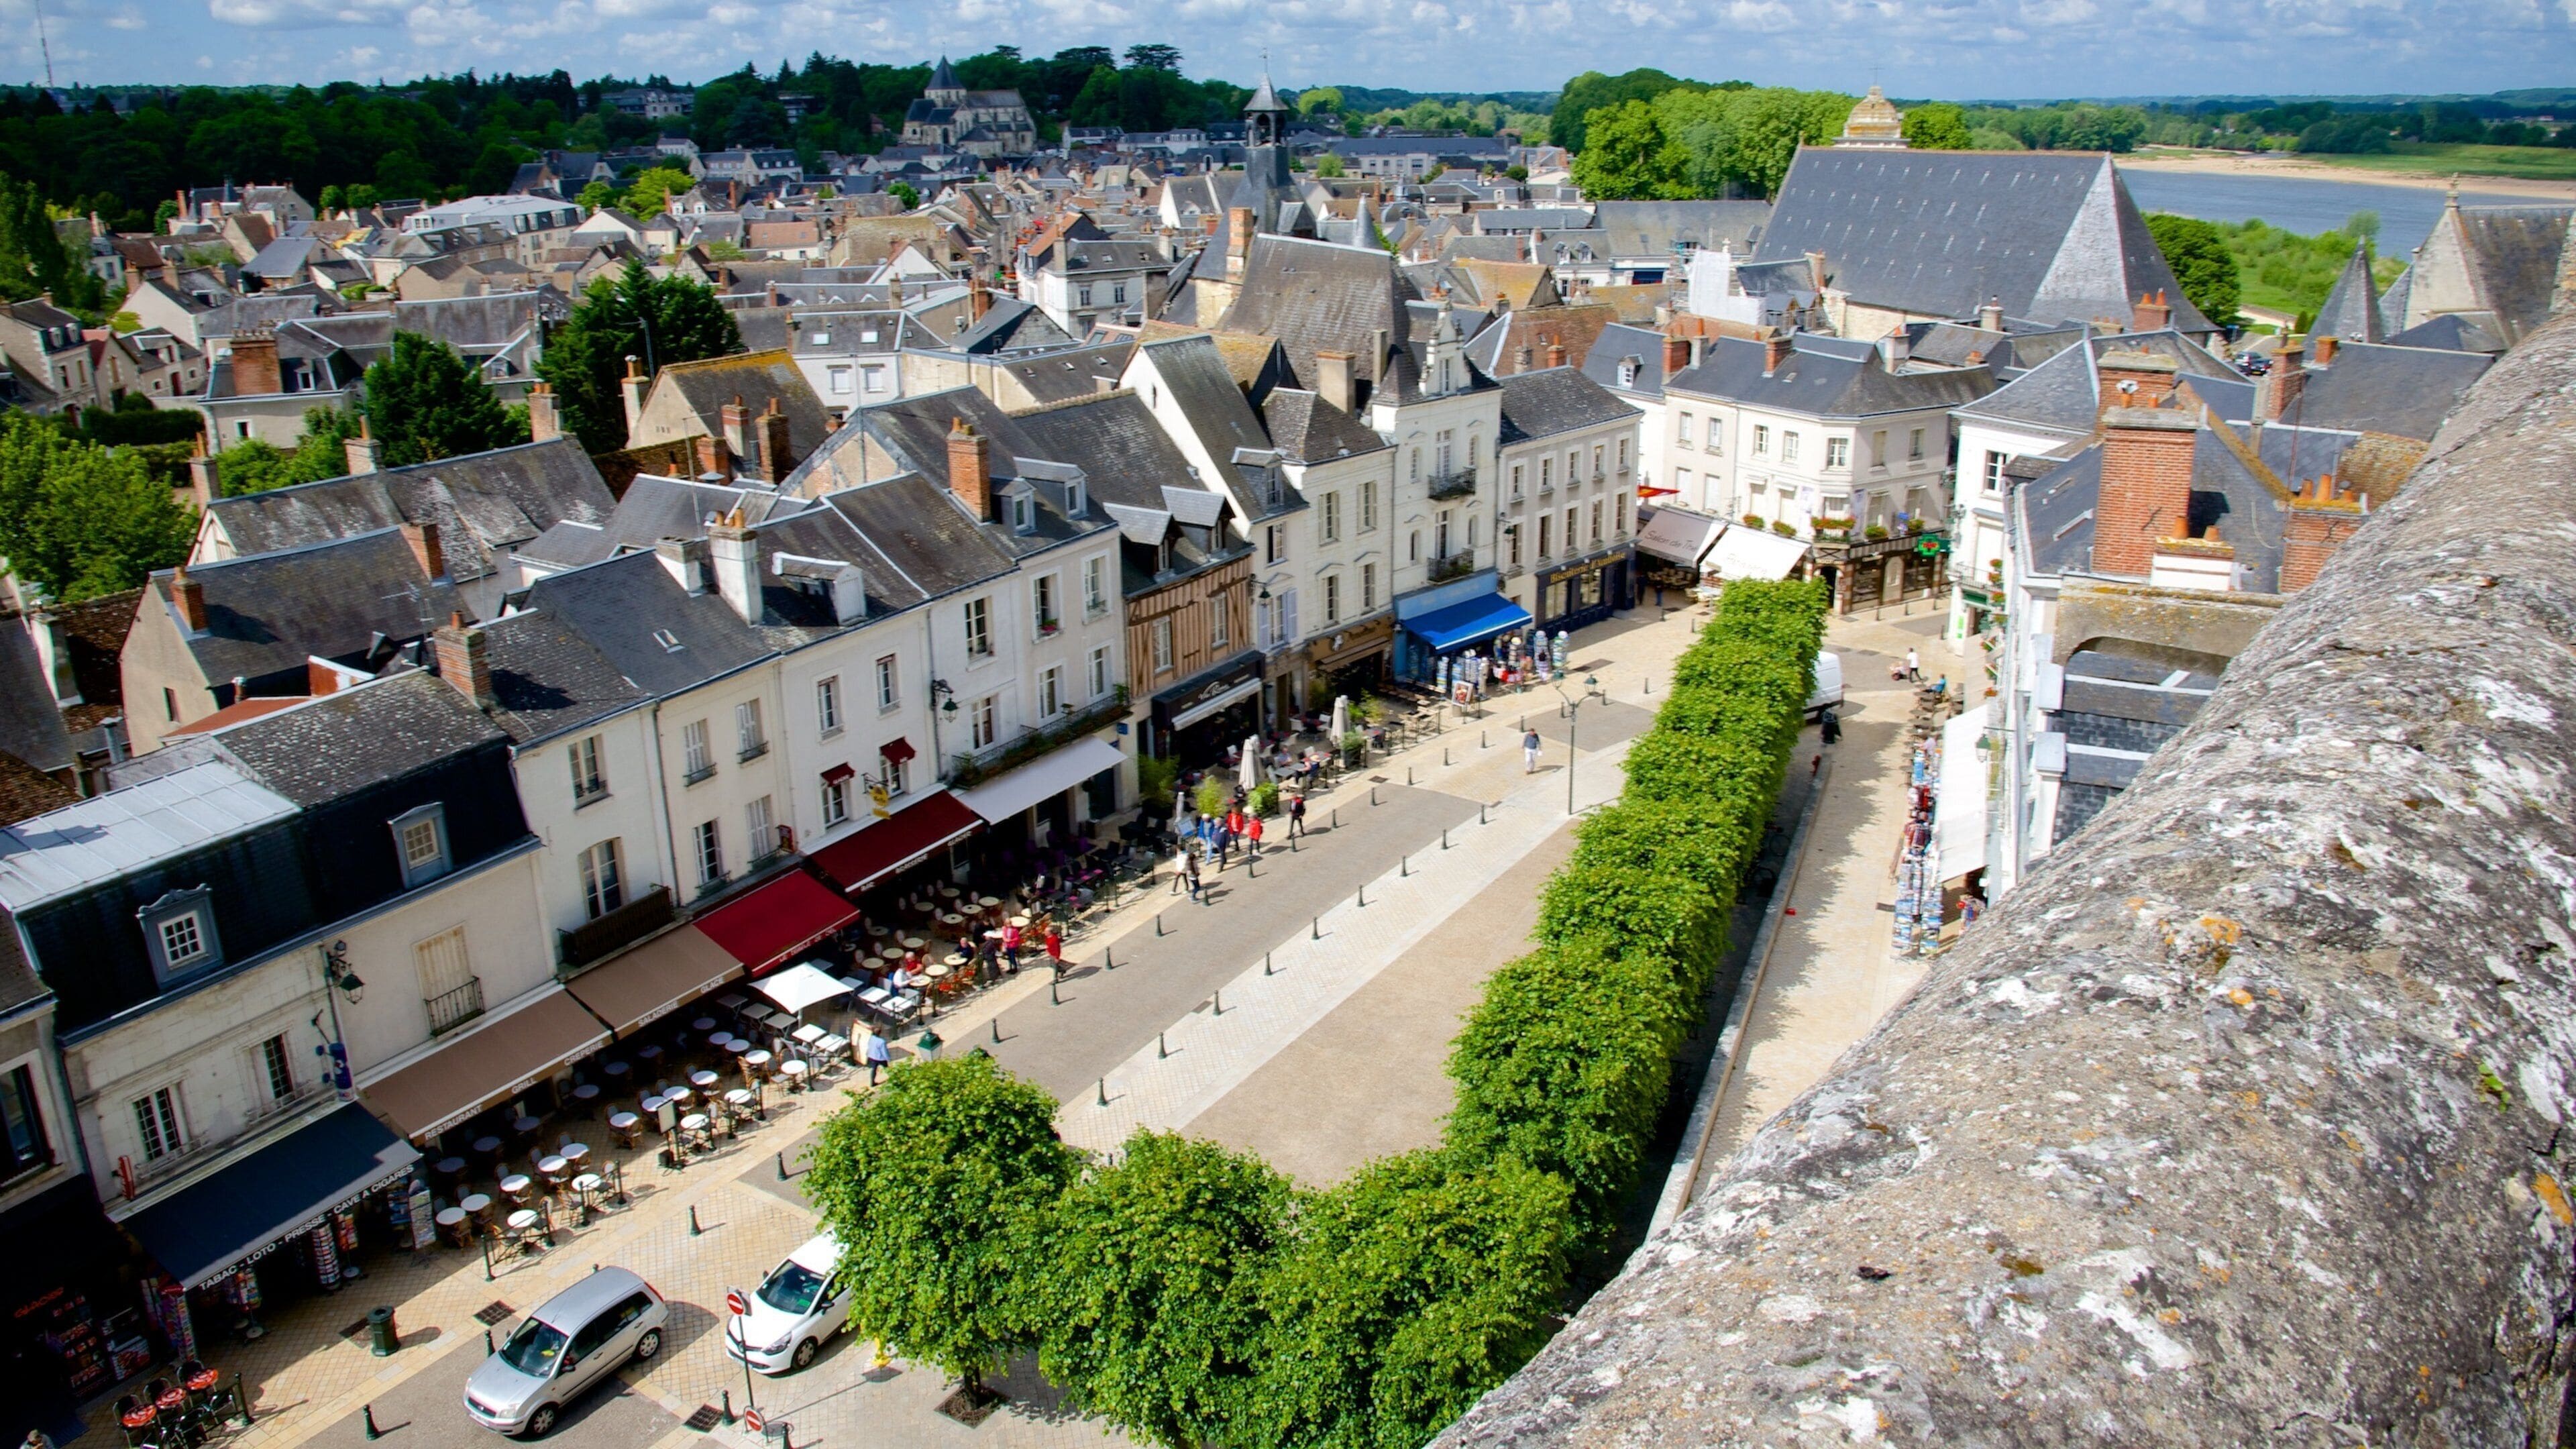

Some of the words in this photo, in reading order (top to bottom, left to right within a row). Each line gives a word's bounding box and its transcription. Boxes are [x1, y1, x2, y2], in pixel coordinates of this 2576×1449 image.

[638, 1000, 679, 1027] SALADERIE
[700, 977, 724, 994] GLACE
[425, 1104, 483, 1140] RESTAURANT
[511, 1077, 537, 1094] GRILL
[564, 1040, 604, 1066] CREPERIE
[199, 1265, 238, 1291] TABAC
[246, 1243, 276, 1265] LOTO
[285, 1213, 326, 1242] PRESSE
[333, 1193, 361, 1214] CAVE
[371, 1165, 415, 1193] CIGARES
